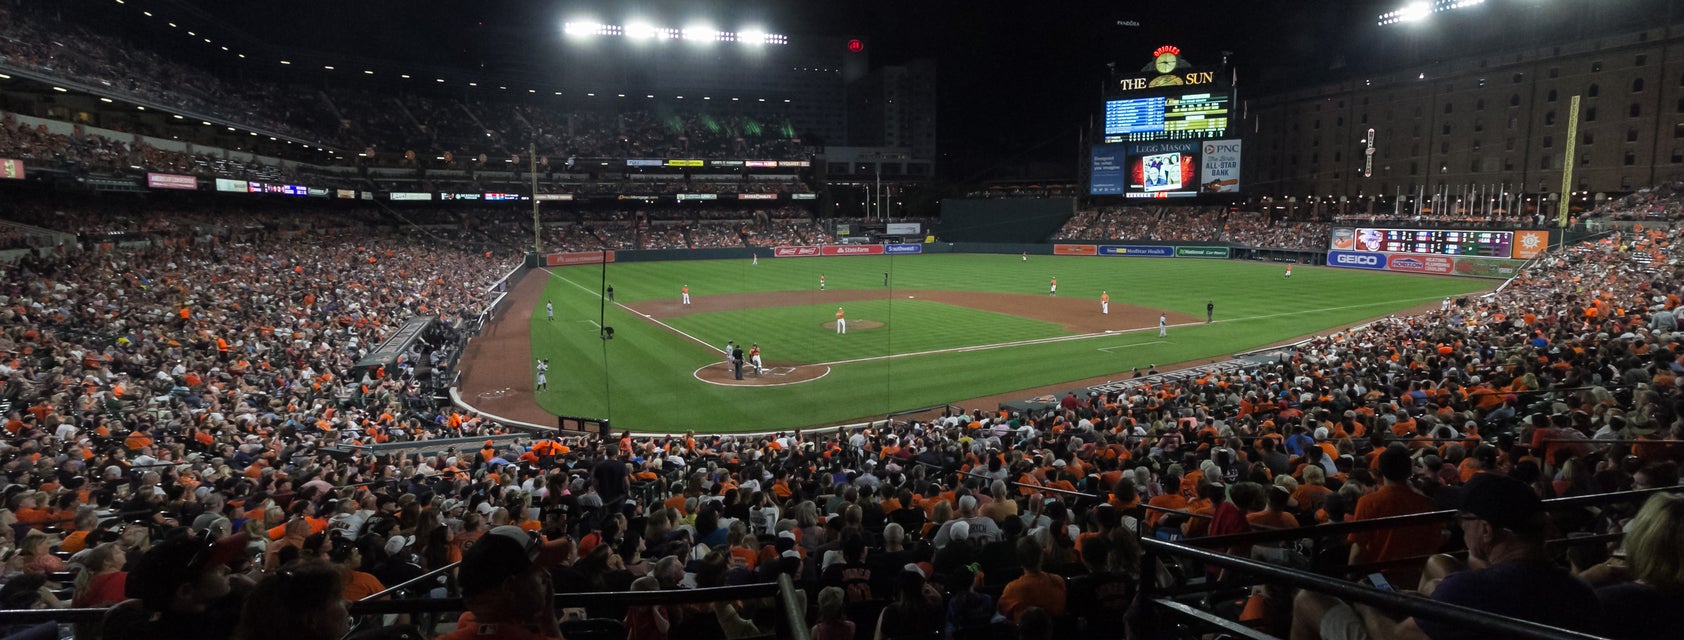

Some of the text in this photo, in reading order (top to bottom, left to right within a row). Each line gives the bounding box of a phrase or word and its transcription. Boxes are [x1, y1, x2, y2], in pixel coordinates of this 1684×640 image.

[1153, 45, 1181, 57] ORIOLES
[1120, 71, 1214, 90] THE SUN
[1136, 143, 1192, 153] LEGG MASON
[1216, 144, 1240, 152] PNC
[1337, 254, 1377, 264] GEICO
